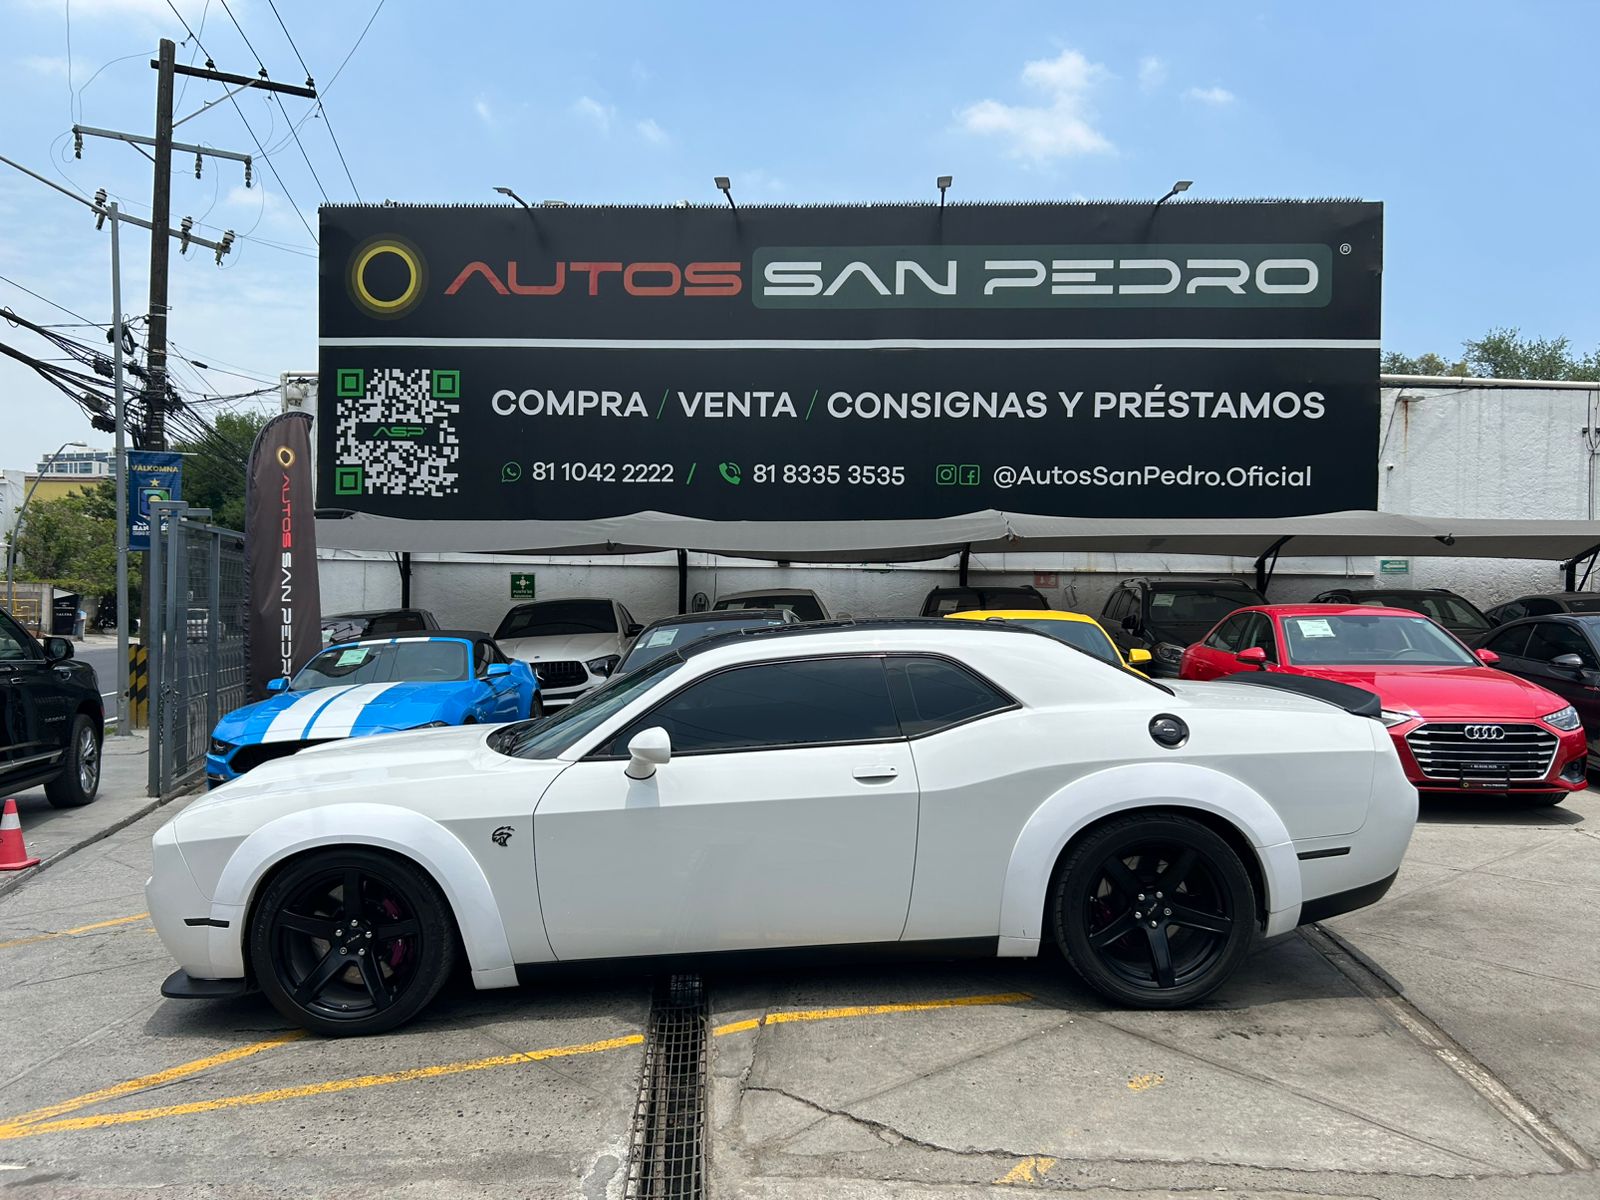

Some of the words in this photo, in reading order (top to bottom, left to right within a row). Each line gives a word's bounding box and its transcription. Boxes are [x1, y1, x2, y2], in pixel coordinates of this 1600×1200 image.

[444, 261, 742, 297] AUTOS
[763, 260, 958, 297] SAN
[983, 258, 1320, 296] PEDRO
[491, 389, 649, 419] COMPRA
[677, 390, 798, 419] VENTA
[827, 390, 1048, 420] CONSIGNAS
[1057, 390, 1084, 419] Y
[1093, 384, 1325, 420] PRÉSTAMOS
[373, 426, 425, 437] ASP
[532, 461, 555, 482] 81
[562, 461, 616, 483] 1042
[622, 462, 674, 484] 2222
[752, 463, 776, 484] 81
[782, 463, 841, 486] 8335
[847, 463, 906, 486] 3535
[993, 464, 1312, 489] @AutosSanPedro.Oficial
[281, 473, 292, 548] AUTOS
[281, 551, 292, 603] SAN
